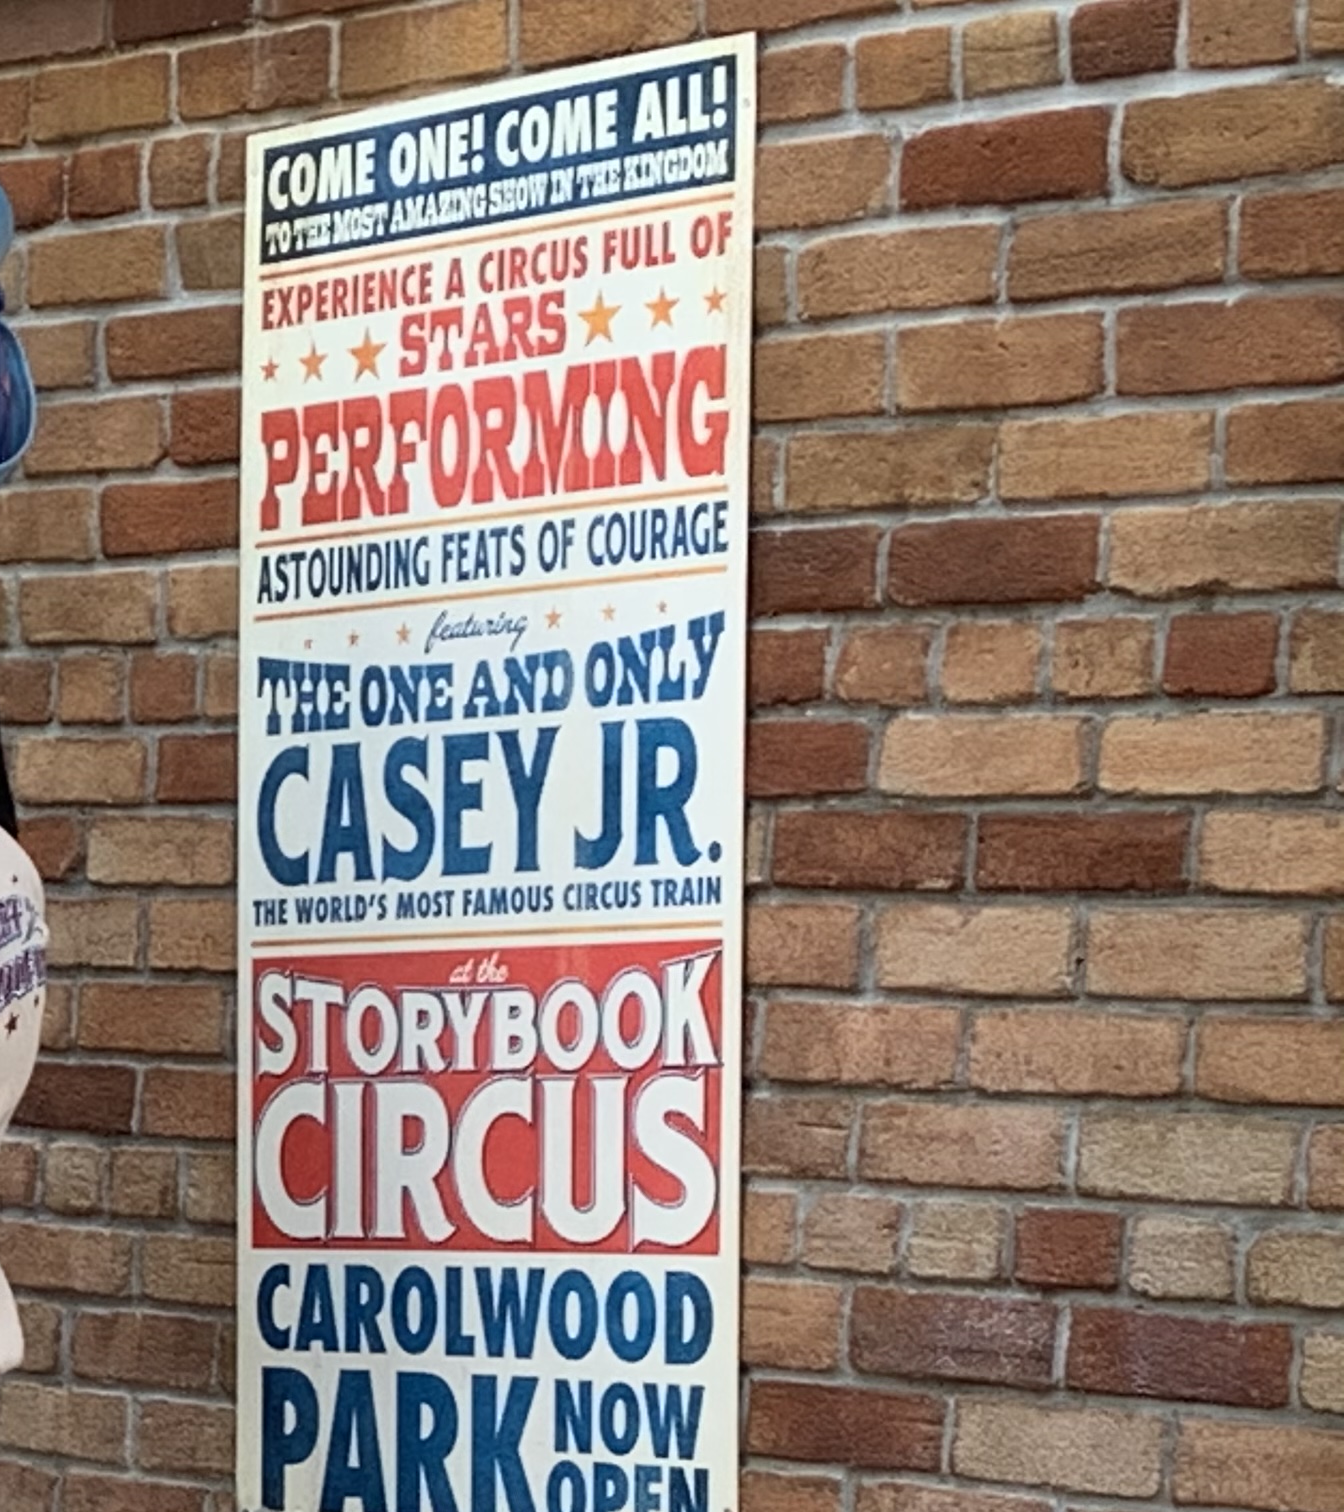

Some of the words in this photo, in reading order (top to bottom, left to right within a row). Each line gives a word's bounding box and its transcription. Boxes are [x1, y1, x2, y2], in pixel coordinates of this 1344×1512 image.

[265, 220, 293, 255] TO
[295, 213, 333, 250] THE
[334, 205, 388, 243] MOST
[390, 188, 487, 234] AMAZING
[488, 179, 548, 218] SHOW
[549, 173, 575, 204] IN
[577, 160, 622, 198] THE
[623, 138, 729, 194] KINGDOM
[267, 138, 376, 210] COME
[389, 114, 485, 187] ONE!
[496, 89, 619, 168] COME
[633, 66, 728, 143] ALL!
[261, 261, 433, 331] EXPERIENCE
[444, 257, 466, 301] A
[479, 235, 588, 293] CIRCUS
[603, 219, 676, 276] FULL
[690, 210, 734, 260] OF
[399, 289, 567, 378] STARS
[259, 343, 729, 532] PERFORMING
[257, 541, 430, 605] ASTOUNDING
[440, 519, 527, 584] FEATS
[538, 518, 576, 573] OF
[587, 500, 729, 567] COURAGE
[257, 656, 351, 736] THE
[359, 662, 454, 728] ONE
[463, 649, 574, 720] AND
[584, 609, 726, 708] ONLY
[423, 609, 529, 655] featuring
[256, 723, 562, 888] CASEY
[574, 716, 723, 871] JR.
[253, 898, 288, 927] THE
[295, 892, 387, 926] WORLD'S
[396, 889, 454, 920] MOST
[462, 883, 554, 916] FAMOUS
[563, 880, 641, 912] CIRCUS
[650, 876, 723, 908] TRAIN
[255, 949, 724, 1077] STORYBOOK
[448, 957, 474, 984] at
[254, 1070, 718, 1253] CIRCUS
[256, 1262, 714, 1365] CAROLWOOD
[554, 1378, 706, 1461] NOW
